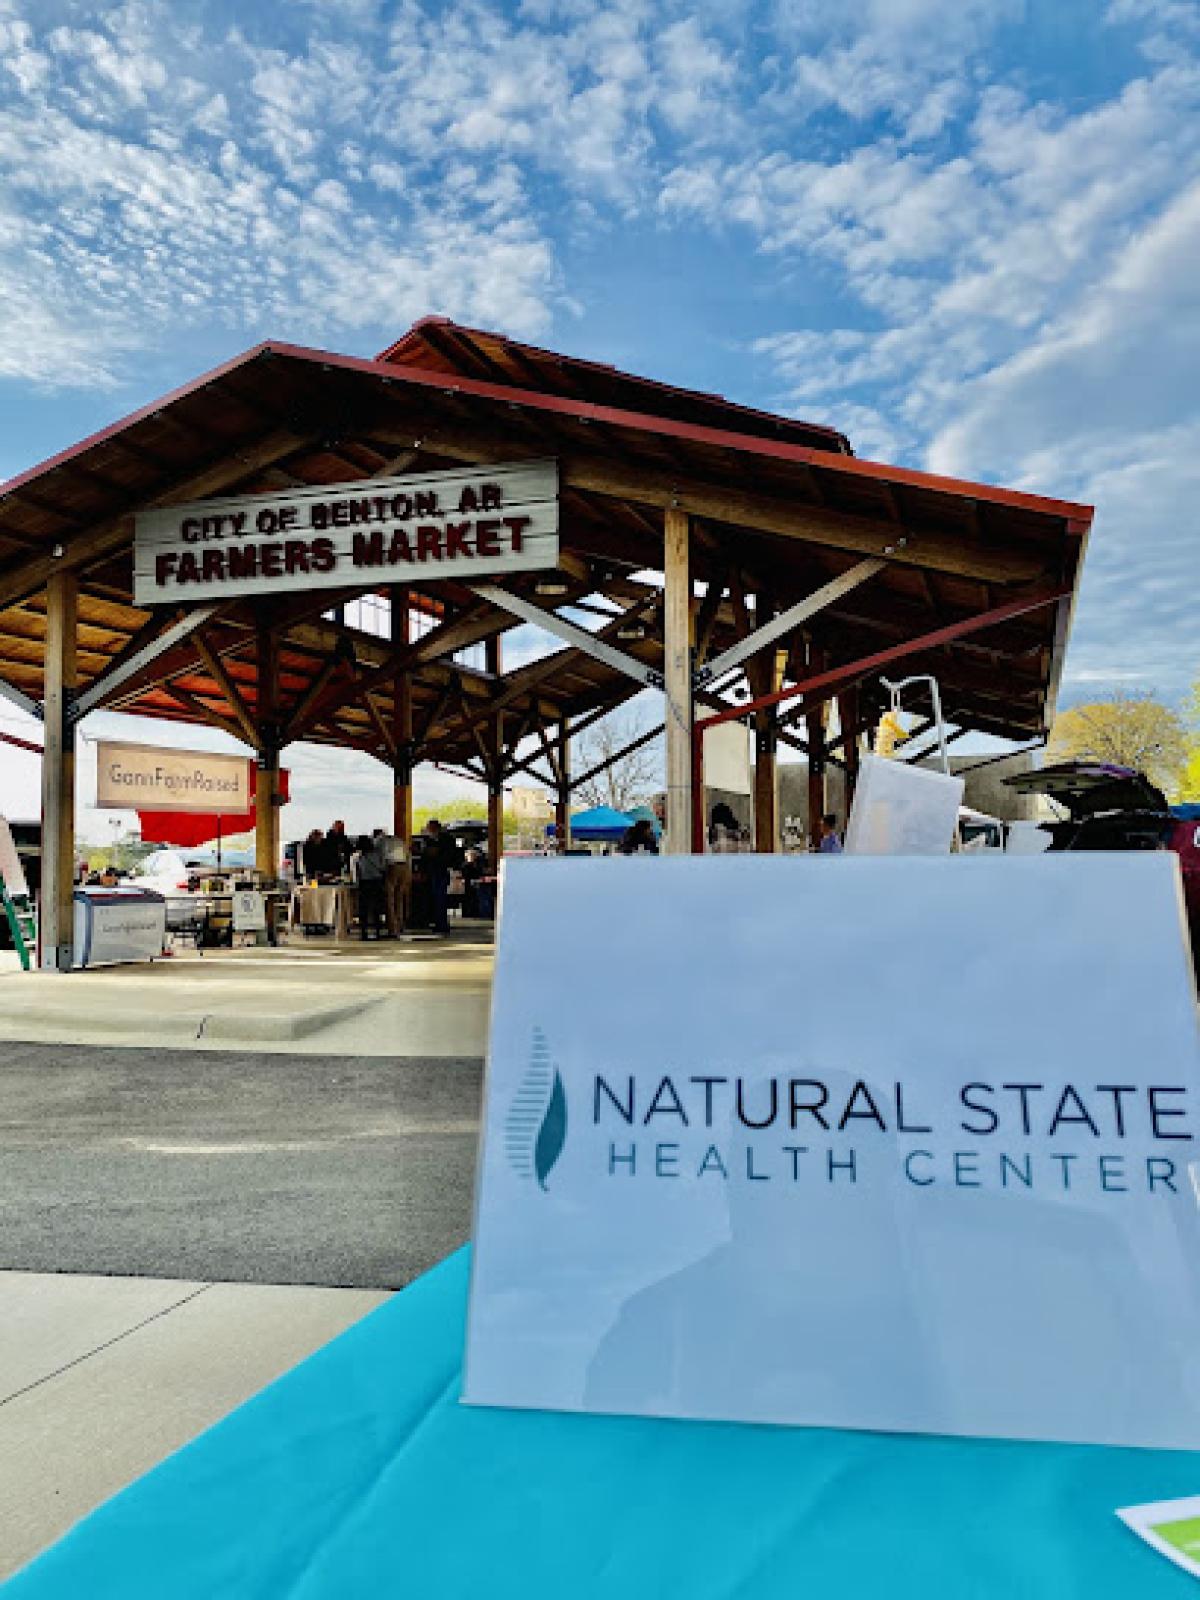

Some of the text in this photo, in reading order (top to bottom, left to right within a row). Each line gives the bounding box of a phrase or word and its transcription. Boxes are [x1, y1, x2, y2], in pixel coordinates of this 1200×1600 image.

[181, 512, 247, 543] CITY
[255, 506, 297, 535] OF
[455, 483, 503, 512] AR
[155, 516, 531, 586] FARMERS MARKET
[593, 1074, 1193, 1141] NATURAL STATE
[608, 1142, 1178, 1194] HEALTH CENTER
